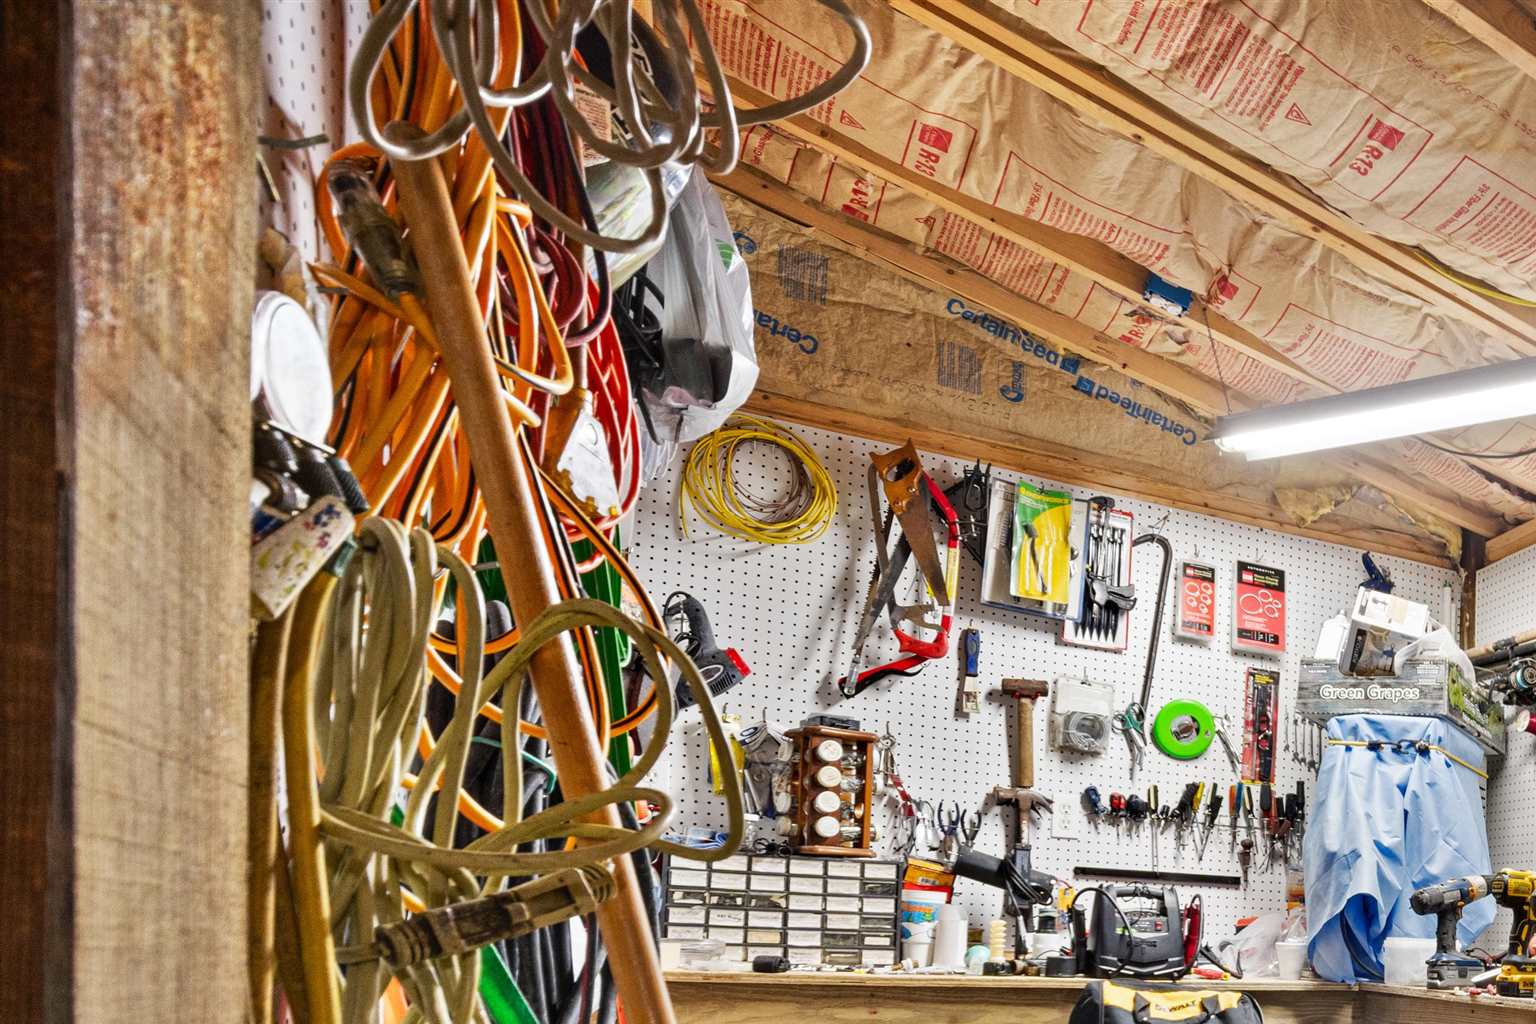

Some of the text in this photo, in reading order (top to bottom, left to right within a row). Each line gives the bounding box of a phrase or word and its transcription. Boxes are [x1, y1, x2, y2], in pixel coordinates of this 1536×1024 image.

[914, 148, 940, 178] R-13
[1349, 142, 1384, 177] R-13
[1096, 386, 1198, 446] CertainTeed
[1321, 686, 1419, 704] Green Grapes
